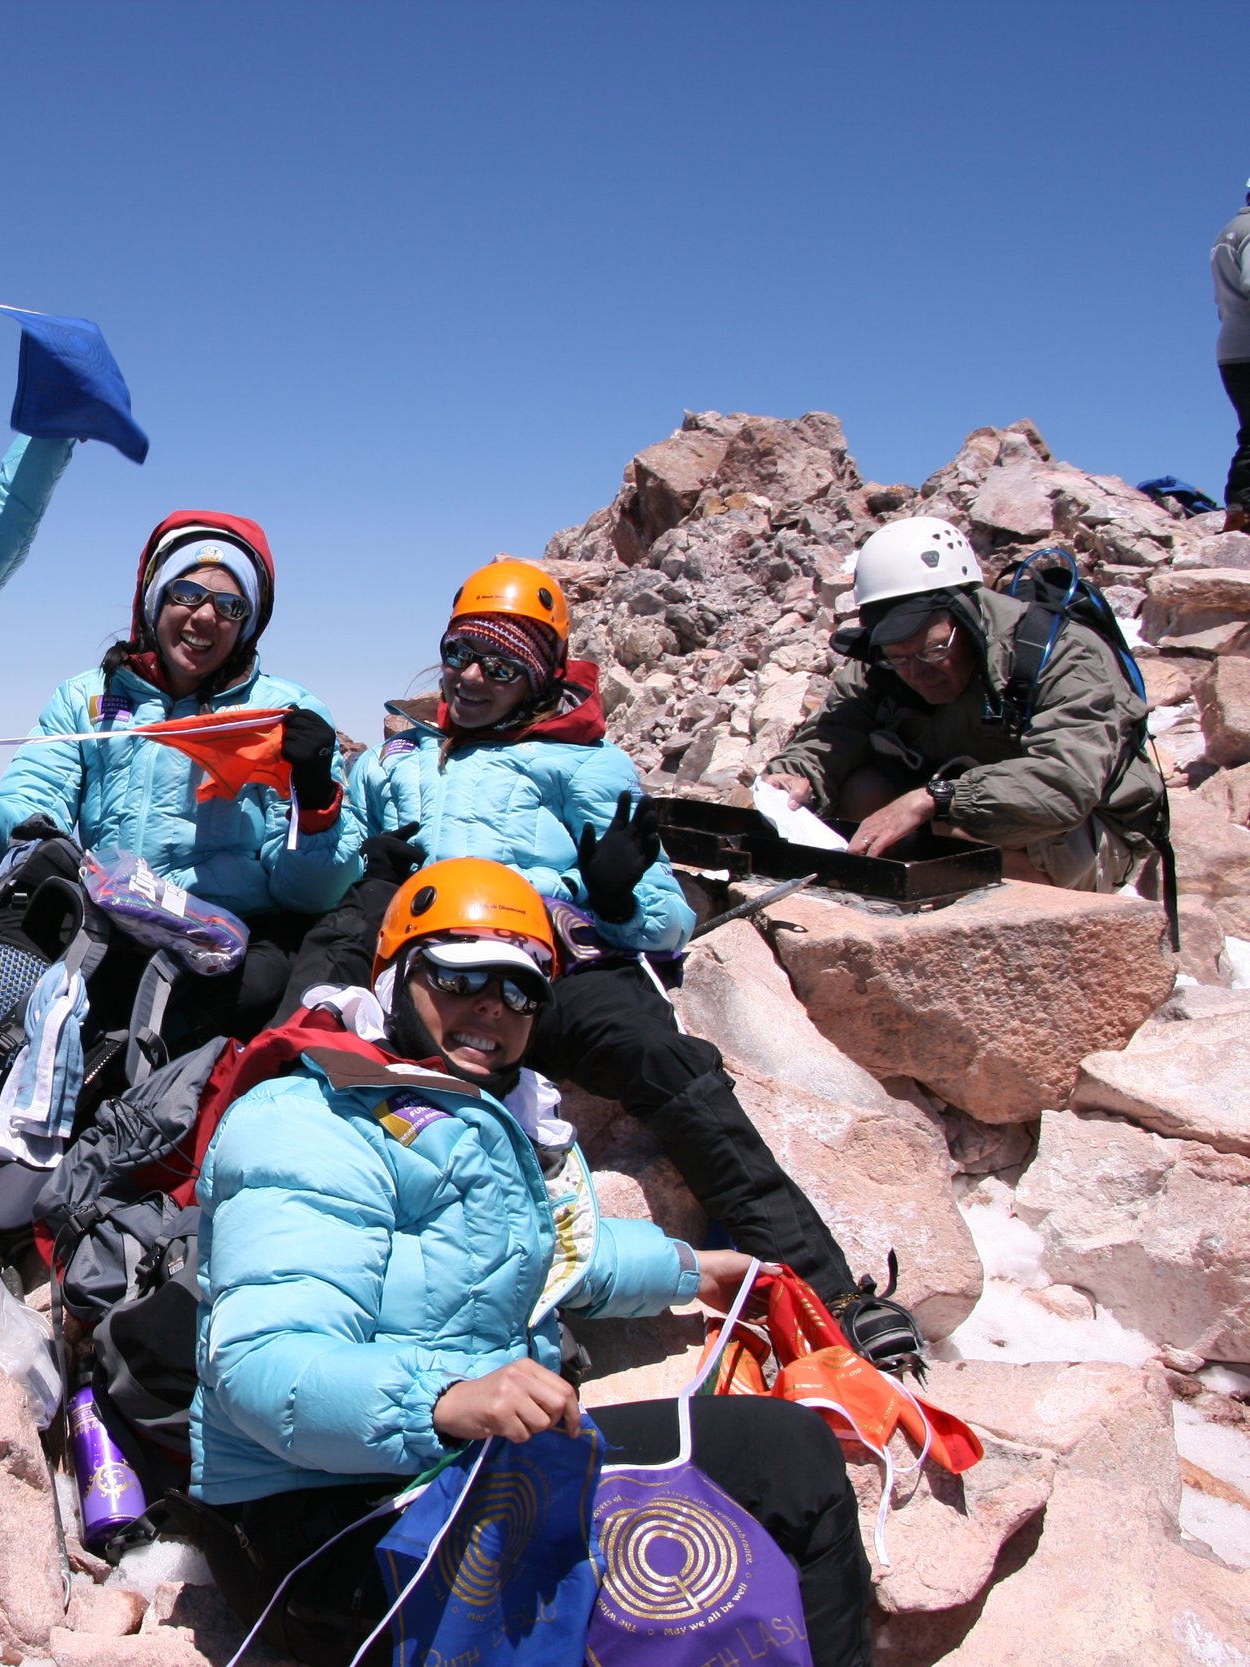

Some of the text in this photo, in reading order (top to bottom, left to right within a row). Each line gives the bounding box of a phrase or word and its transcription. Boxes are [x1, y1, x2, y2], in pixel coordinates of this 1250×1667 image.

[663, 1582, 749, 1637] May we all be well
[736, 1615, 808, 1660] LASL
